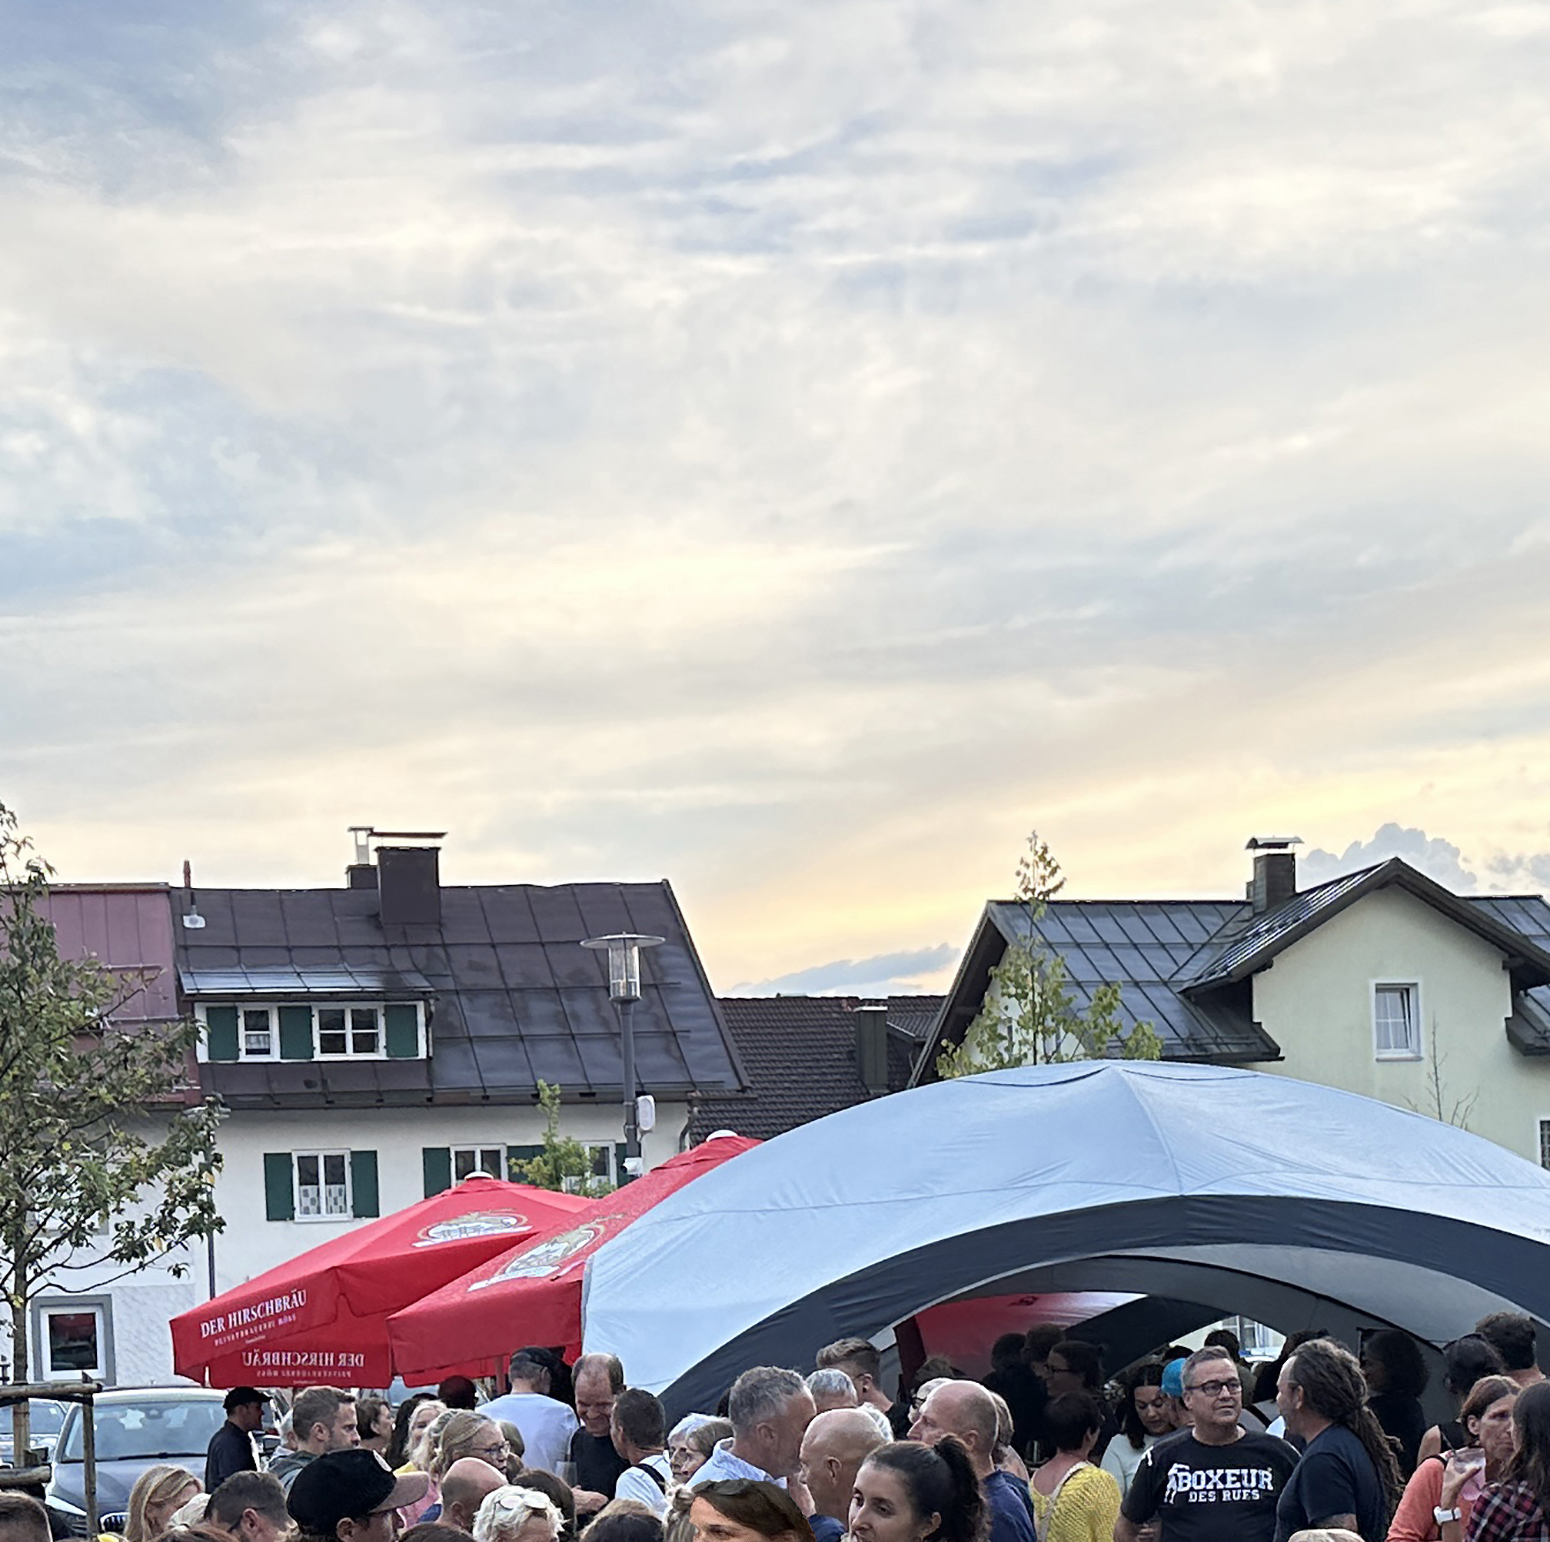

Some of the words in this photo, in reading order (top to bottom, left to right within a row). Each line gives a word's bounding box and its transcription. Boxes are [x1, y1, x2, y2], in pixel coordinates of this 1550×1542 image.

[200, 1316, 226, 1339] DER
[228, 1288, 308, 1330] HIRSCHBRÄU
[1177, 1468, 1274, 1492] BOXEUR
[1188, 1490, 1217, 1503] DES
